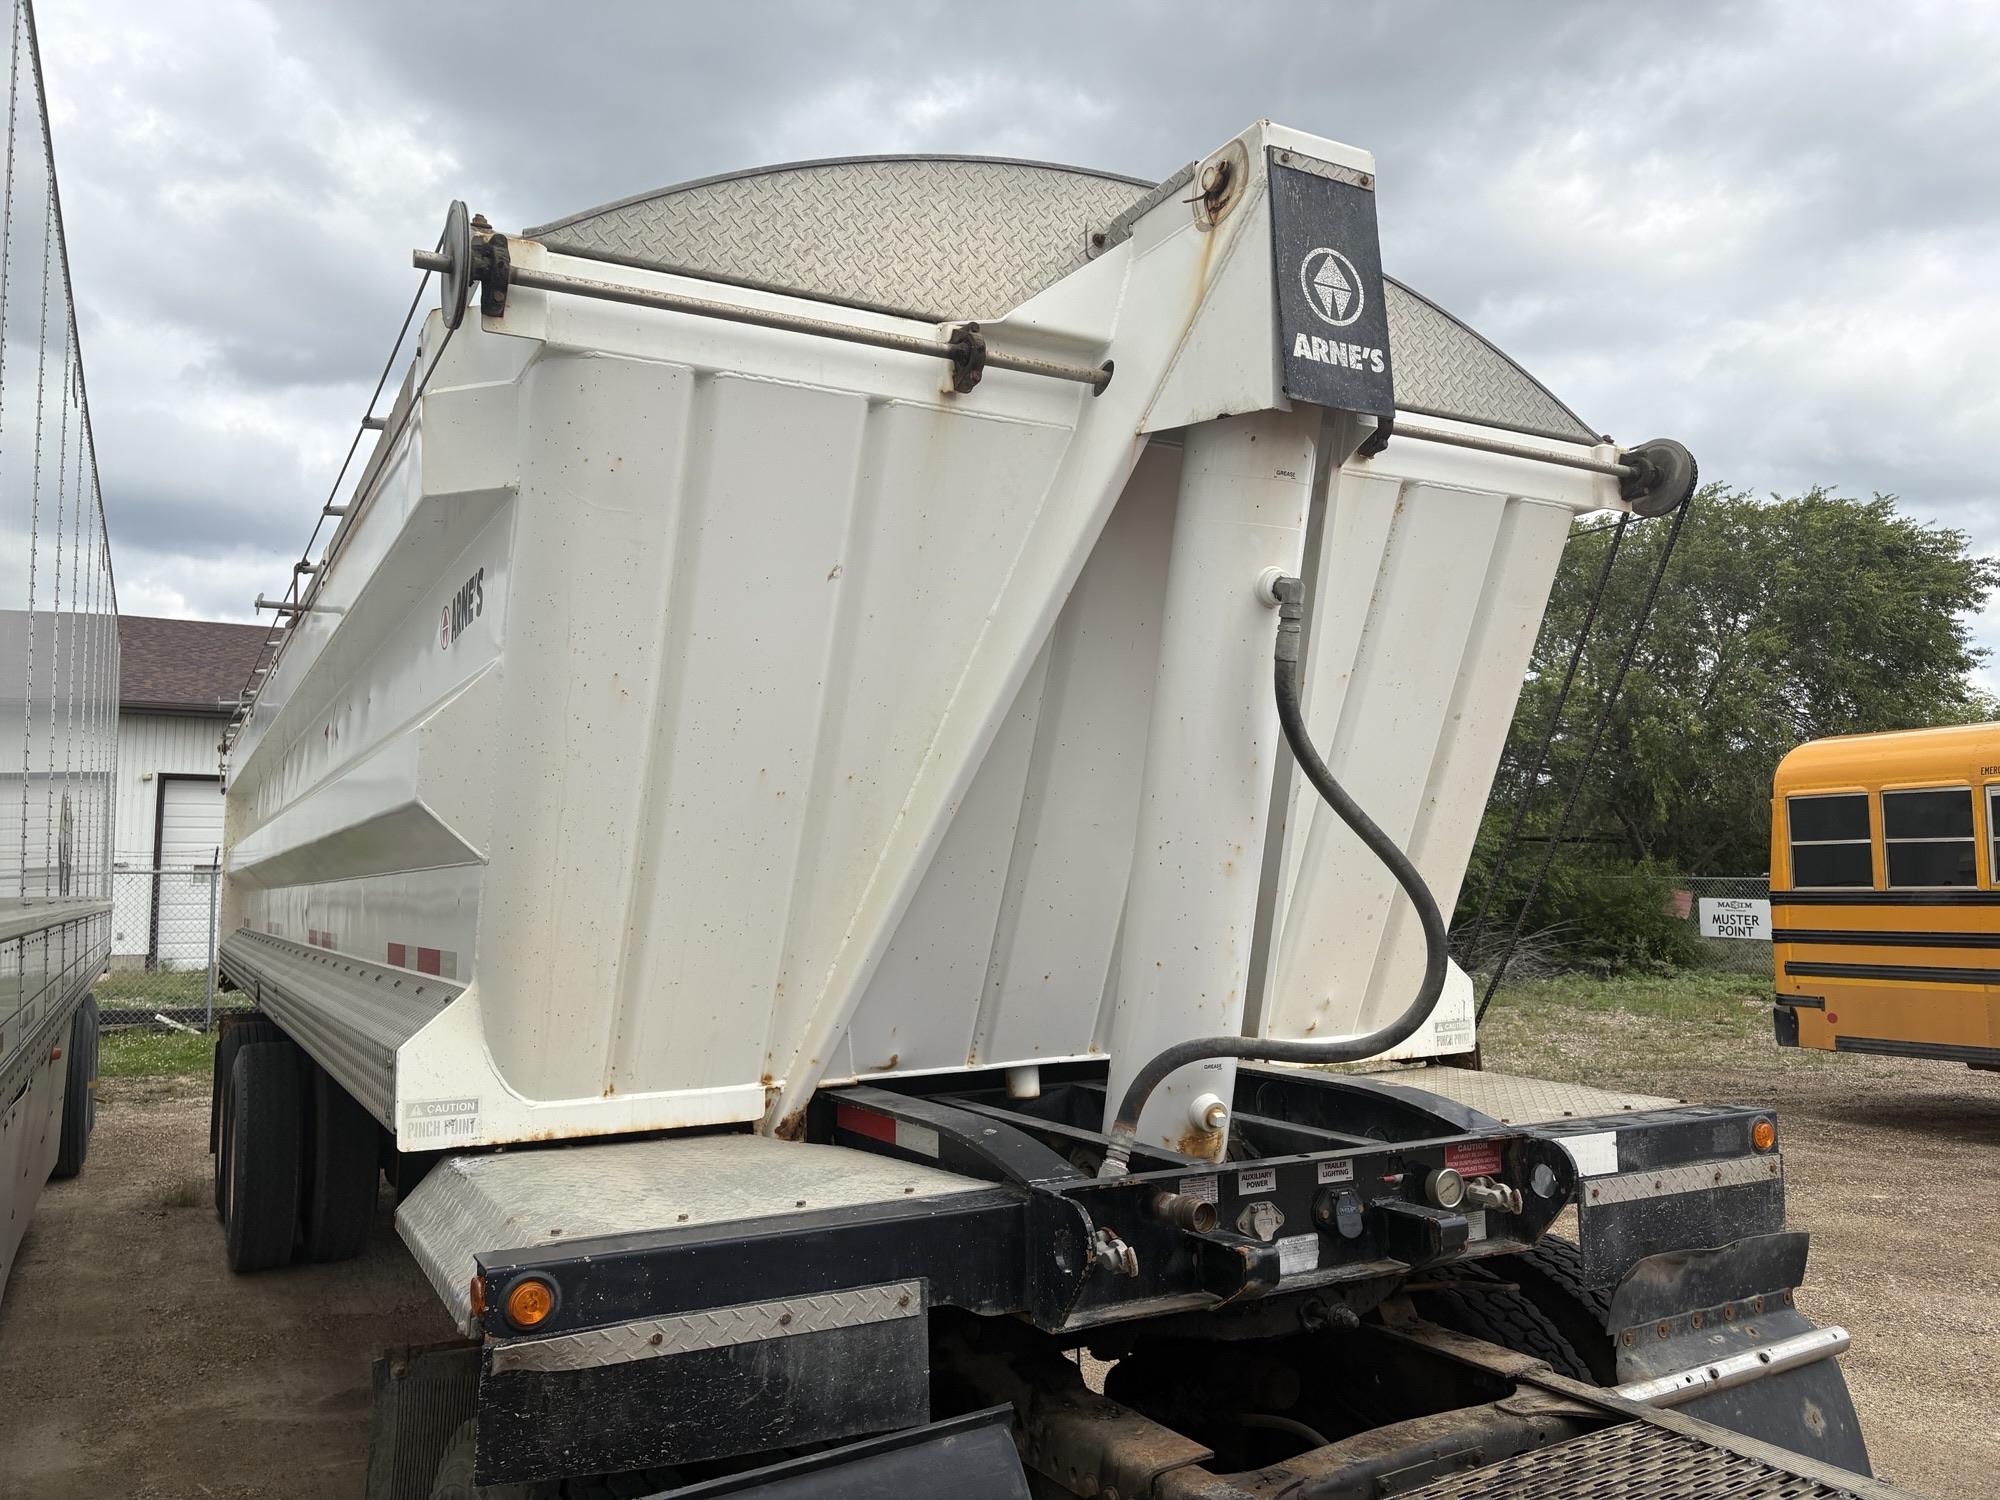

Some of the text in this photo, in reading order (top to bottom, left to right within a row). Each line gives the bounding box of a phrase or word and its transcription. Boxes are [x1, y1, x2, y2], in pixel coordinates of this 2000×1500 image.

[1293, 332, 1385, 373] ARNE'S
[1276, 469, 1296, 478] GREASE
[451, 567, 484, 644] ARNE'S
[1717, 900, 1752, 909] MAXIM
[1712, 913, 1760, 926] MUSTER
[1718, 925, 1754, 937] POINT
[427, 1102, 475, 1114] CAUTION
[407, 1117, 476, 1139] PINCH POINT
[1457, 1142, 1488, 1152] CAUTION
[1324, 1161, 1347, 1170] TRAILER
[1241, 1171, 1272, 1181] AUXILIARY
[1322, 1168, 1349, 1178] LIGHTING
[1246, 1180, 1268, 1189] POWER
